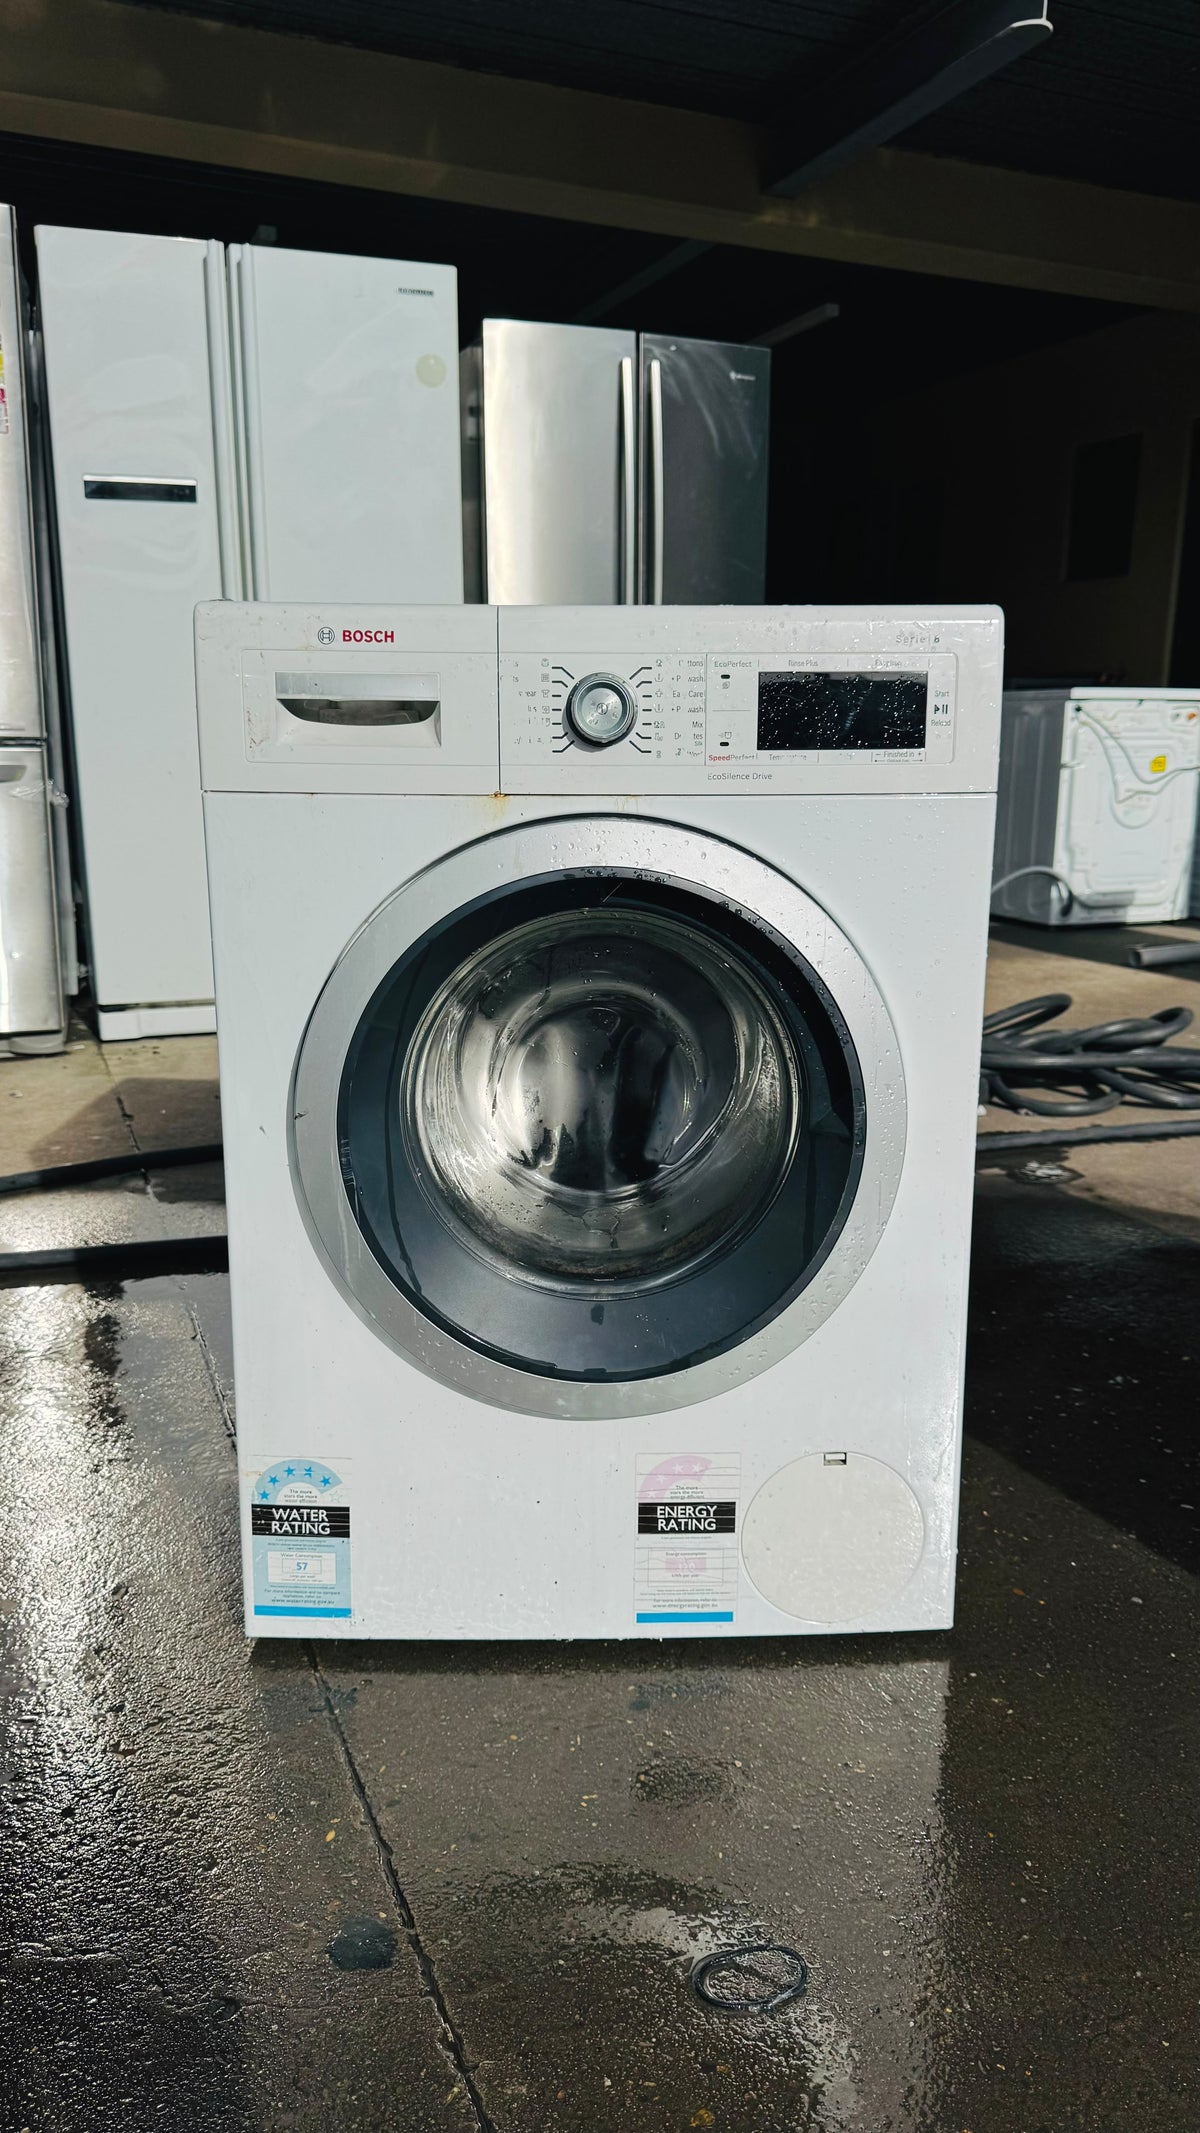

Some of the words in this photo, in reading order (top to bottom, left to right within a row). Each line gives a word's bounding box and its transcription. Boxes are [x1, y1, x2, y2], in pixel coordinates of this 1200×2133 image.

[342, 629, 394, 643] BOSCH
[895, 634, 926, 646] Serie
[933, 635, 941, 644] 6
[714, 660, 752, 668] EcoPerfect
[688, 690, 704, 698] Care
[934, 690, 950, 698] Start
[691, 720, 704, 729] Mix
[708, 754, 755, 763] SpeedPerfect
[883, 751, 907, 759] Finished
[707, 772, 750, 781] EcoSilence
[752, 772, 773, 780] Drive
[271, 1507, 329, 1522] WATER
[657, 1505, 717, 1518] ENERGY
[271, 1520, 331, 1535] RATING
[658, 1518, 716, 1531] RATING
[296, 1562, 308, 1571] 57
